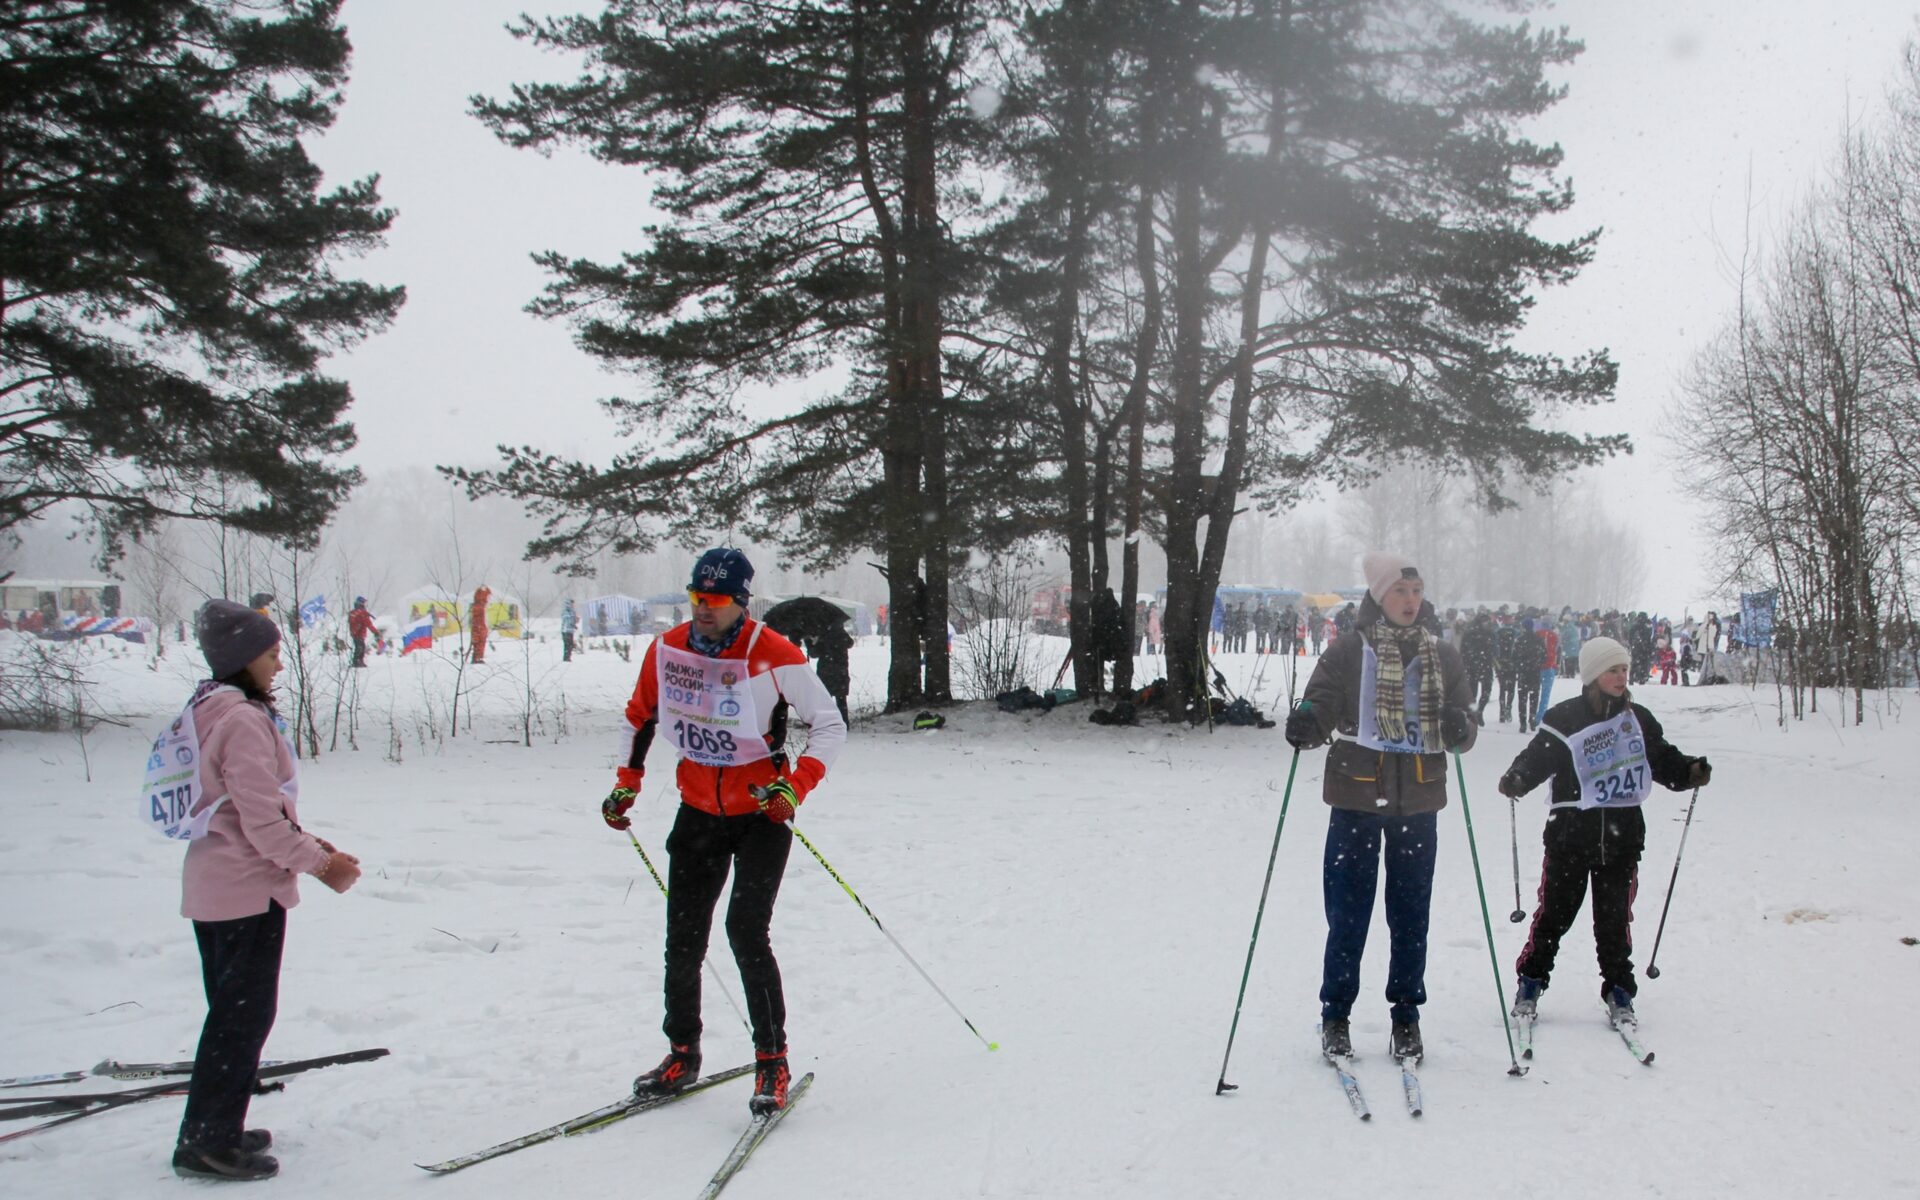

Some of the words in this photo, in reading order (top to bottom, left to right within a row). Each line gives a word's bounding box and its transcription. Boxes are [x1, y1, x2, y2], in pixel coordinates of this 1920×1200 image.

[701, 562, 728, 579] DNB
[665, 661, 704, 680] ЛЫЖНЯ
[665, 673, 704, 692] РОССИИ
[666, 687, 702, 706] 2021
[673, 719, 737, 754] 1668
[1583, 727, 1615, 748] ЛЫЖНЯ
[1594, 765, 1644, 803] 3247
[151, 784, 192, 826] 4787
